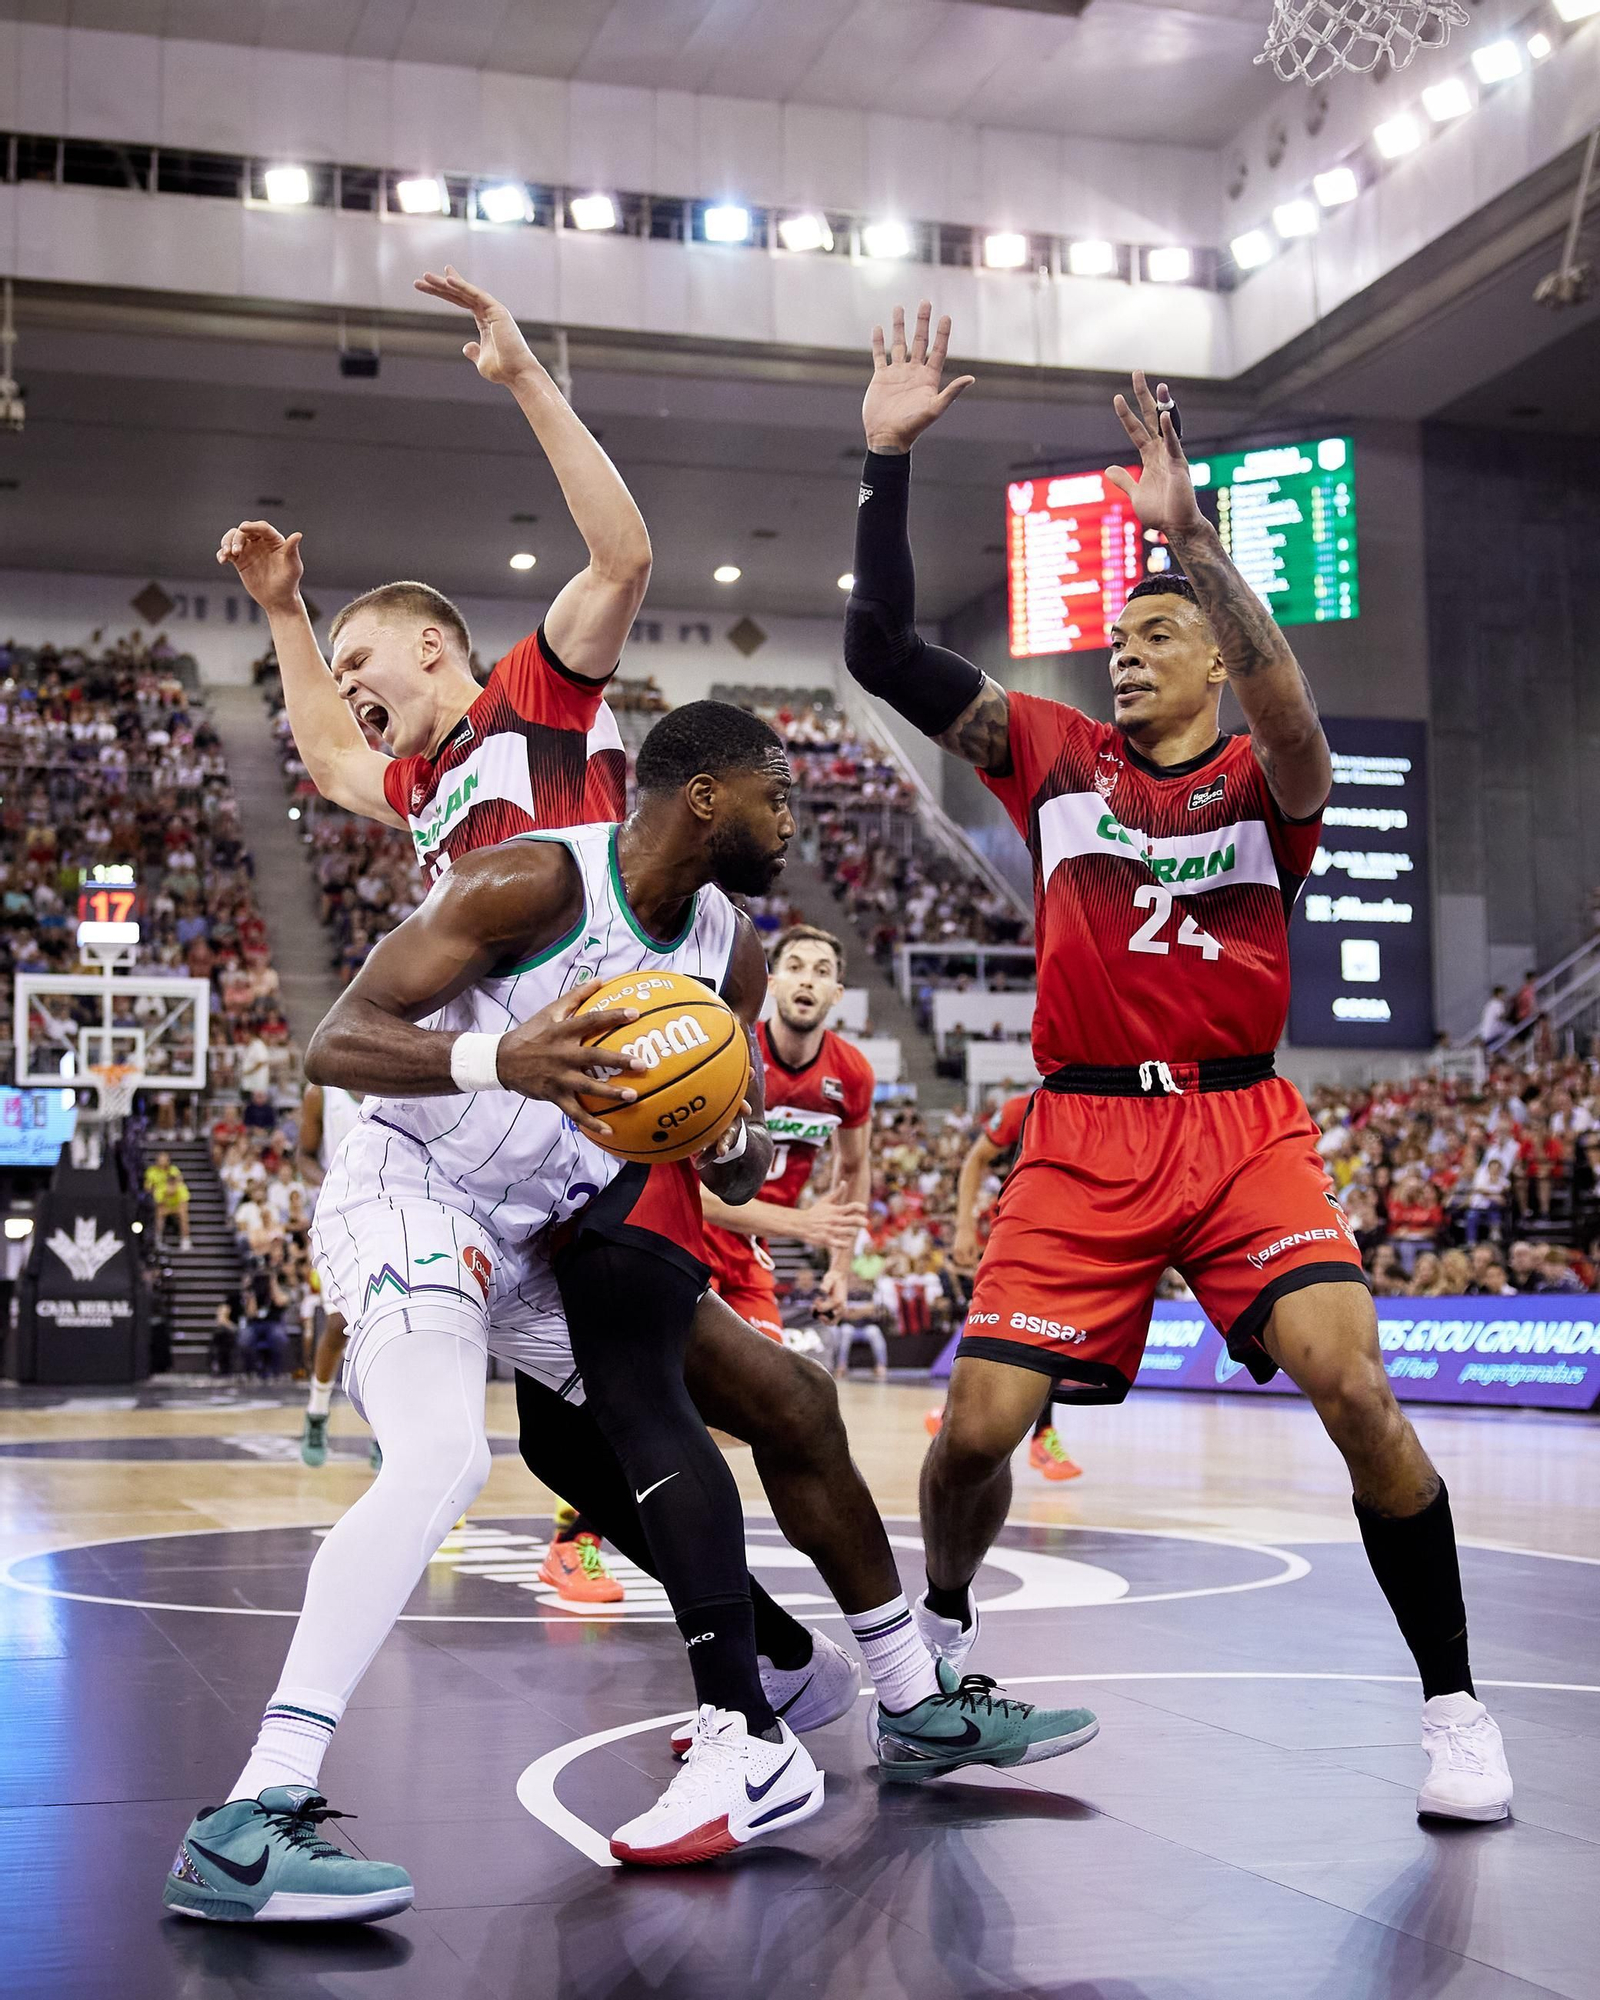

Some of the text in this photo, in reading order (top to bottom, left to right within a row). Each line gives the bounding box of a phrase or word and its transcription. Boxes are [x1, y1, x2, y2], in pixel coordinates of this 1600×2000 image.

[1096, 814, 1235, 882] CRAN
[90, 891, 135, 923] 17
[1128, 884, 1225, 961] 24
[589, 986, 634, 1012] end
[585, 1015, 710, 1082] Wil
[658, 1095, 706, 1129] acb
[1258, 1228, 1339, 1262] BERNER
[968, 1311, 1000, 1325] vive
[685, 1632, 715, 1650] AKO
